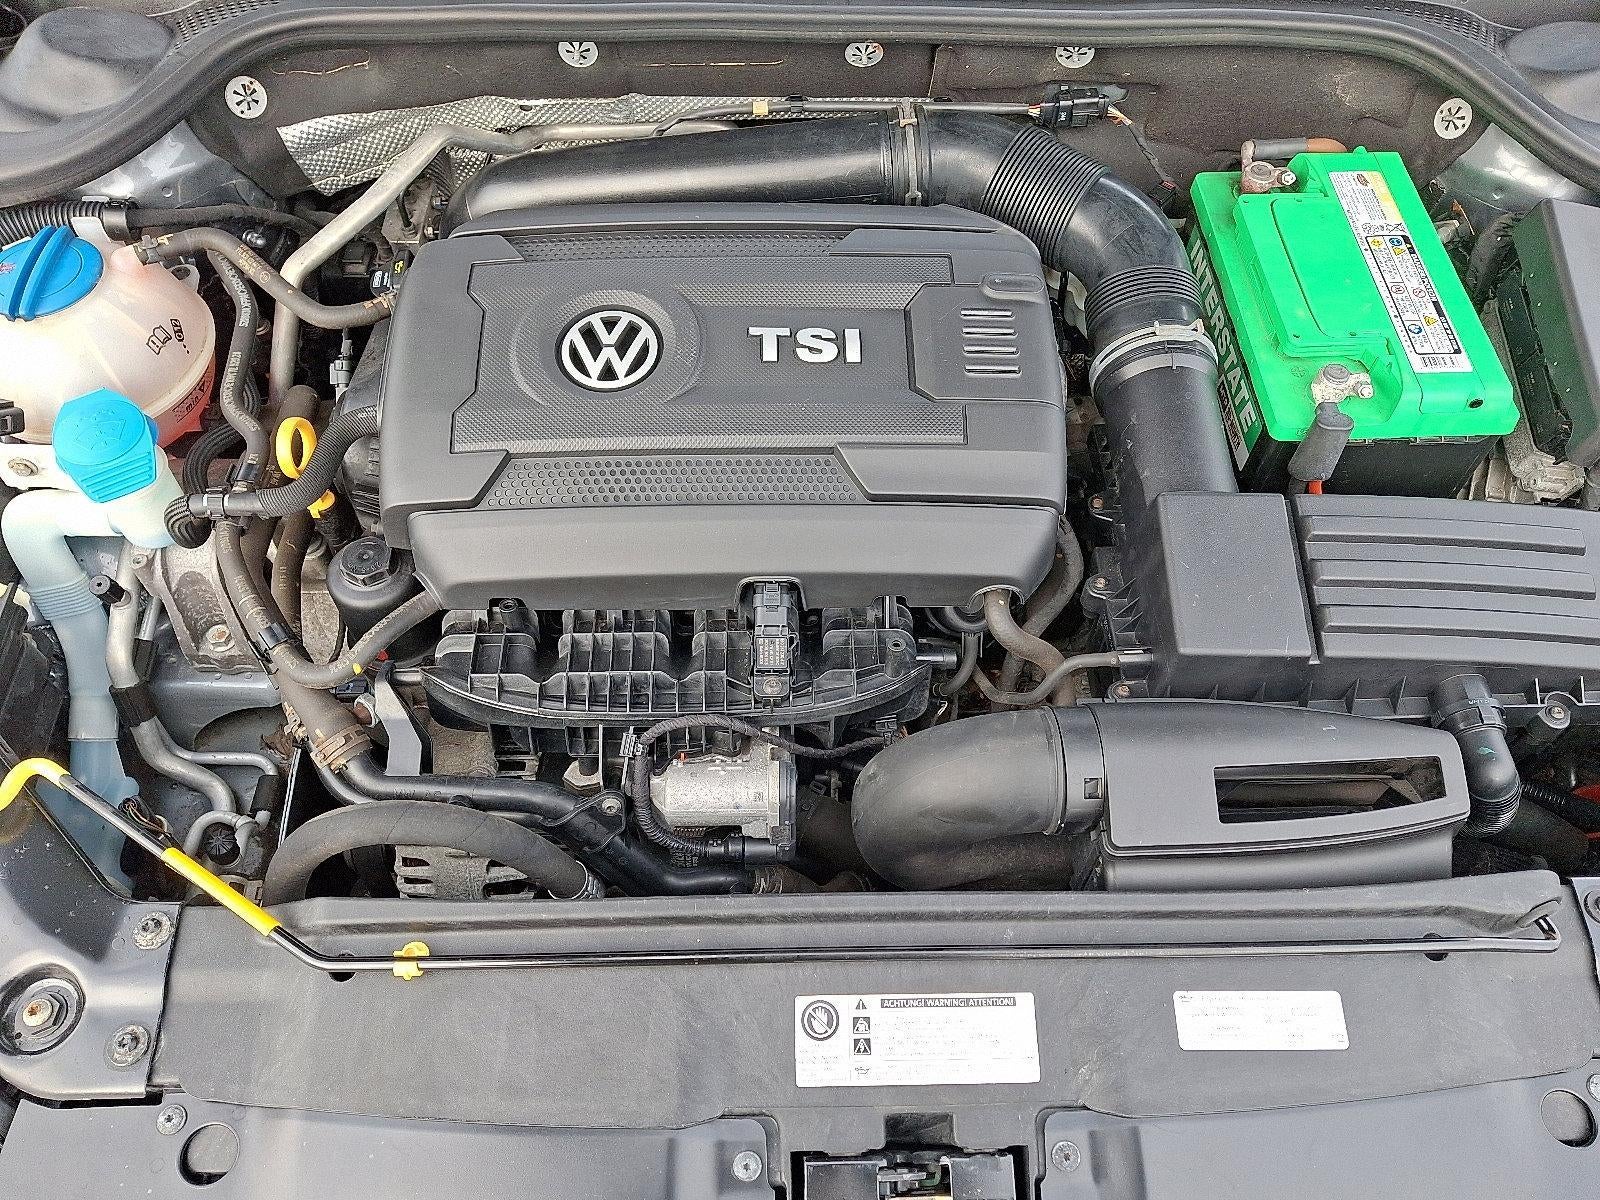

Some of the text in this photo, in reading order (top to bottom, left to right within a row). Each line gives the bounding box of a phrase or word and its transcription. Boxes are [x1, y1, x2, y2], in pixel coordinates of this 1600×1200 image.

[748, 326, 863, 364] TSI
[1190, 239, 1257, 432] INTERSTATE
[186, 396, 199, 412] min
[883, 997, 1014, 1008] ACHTUNG! WARNING! ATTENTION!
